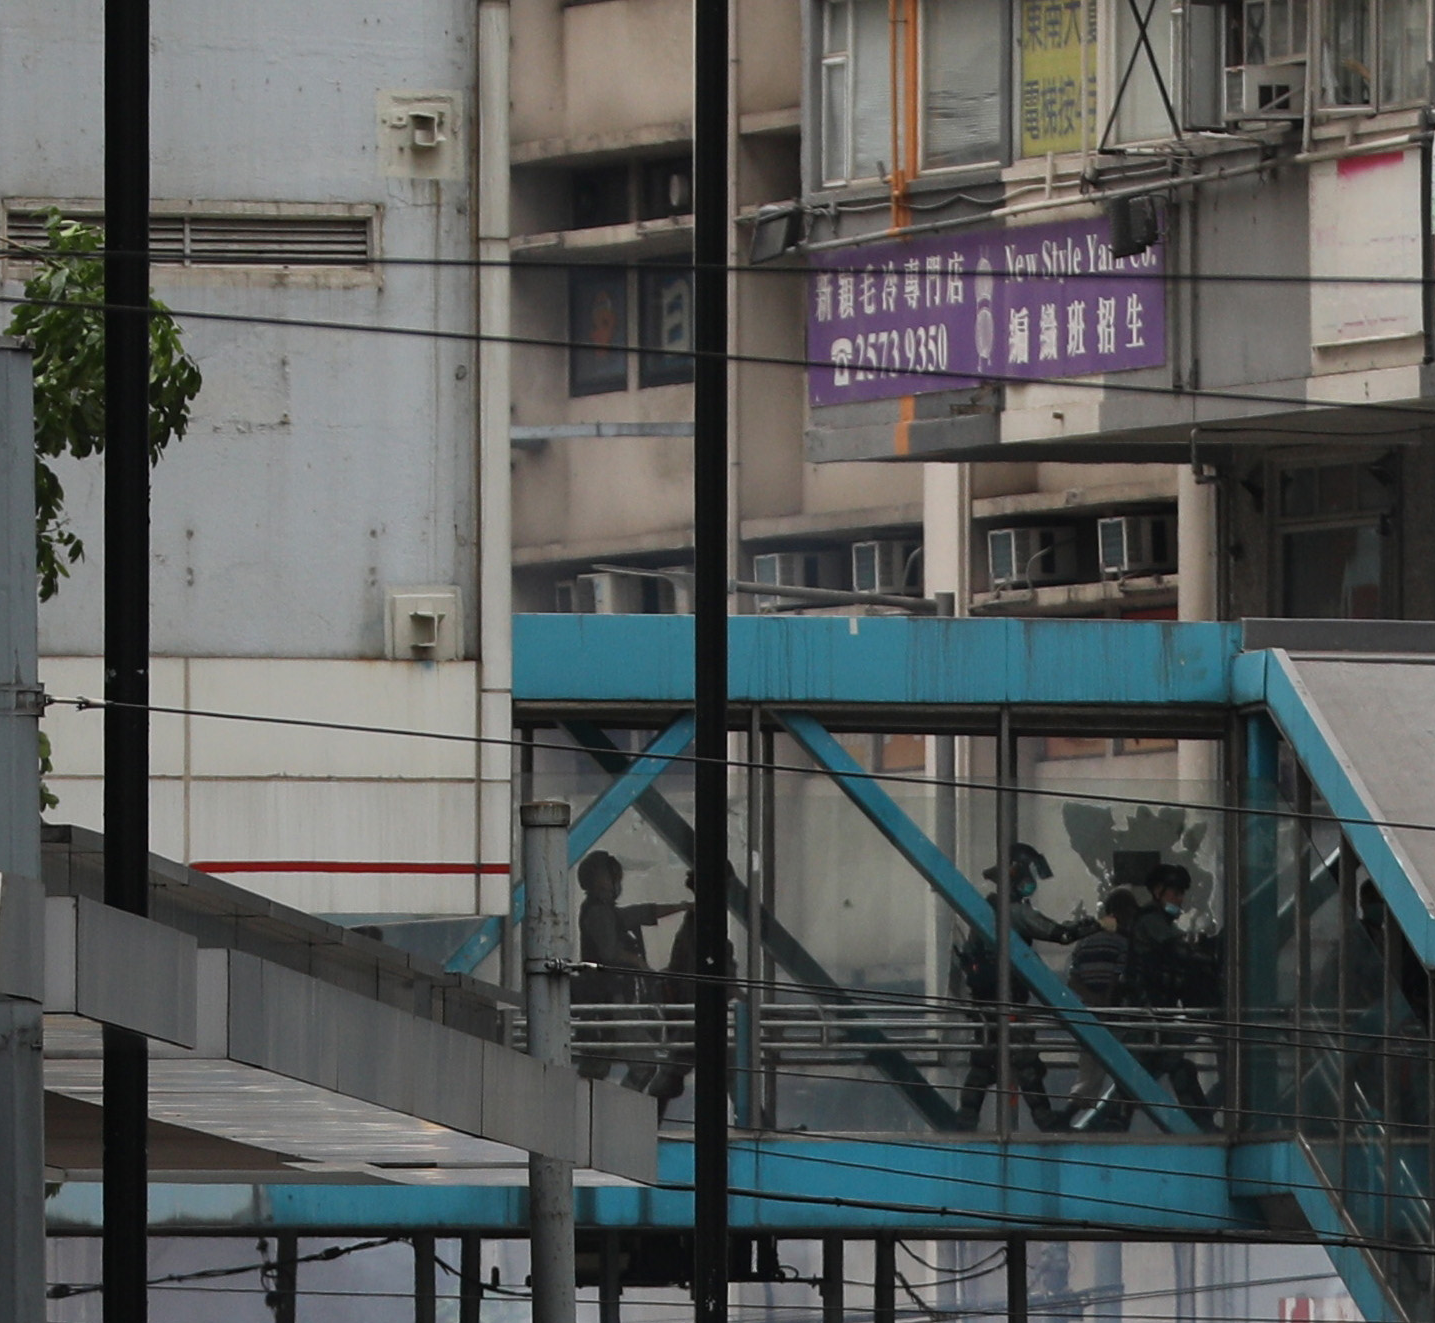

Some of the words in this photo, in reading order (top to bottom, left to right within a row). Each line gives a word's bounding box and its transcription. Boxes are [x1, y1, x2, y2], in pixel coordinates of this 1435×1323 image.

[1005, 244, 1037, 283] New
[1042, 240, 1081, 284] Style
[855, 330, 899, 382] 2573
[904, 324, 947, 372] 9350
[1008, 293, 1145, 363] 編織班招生
